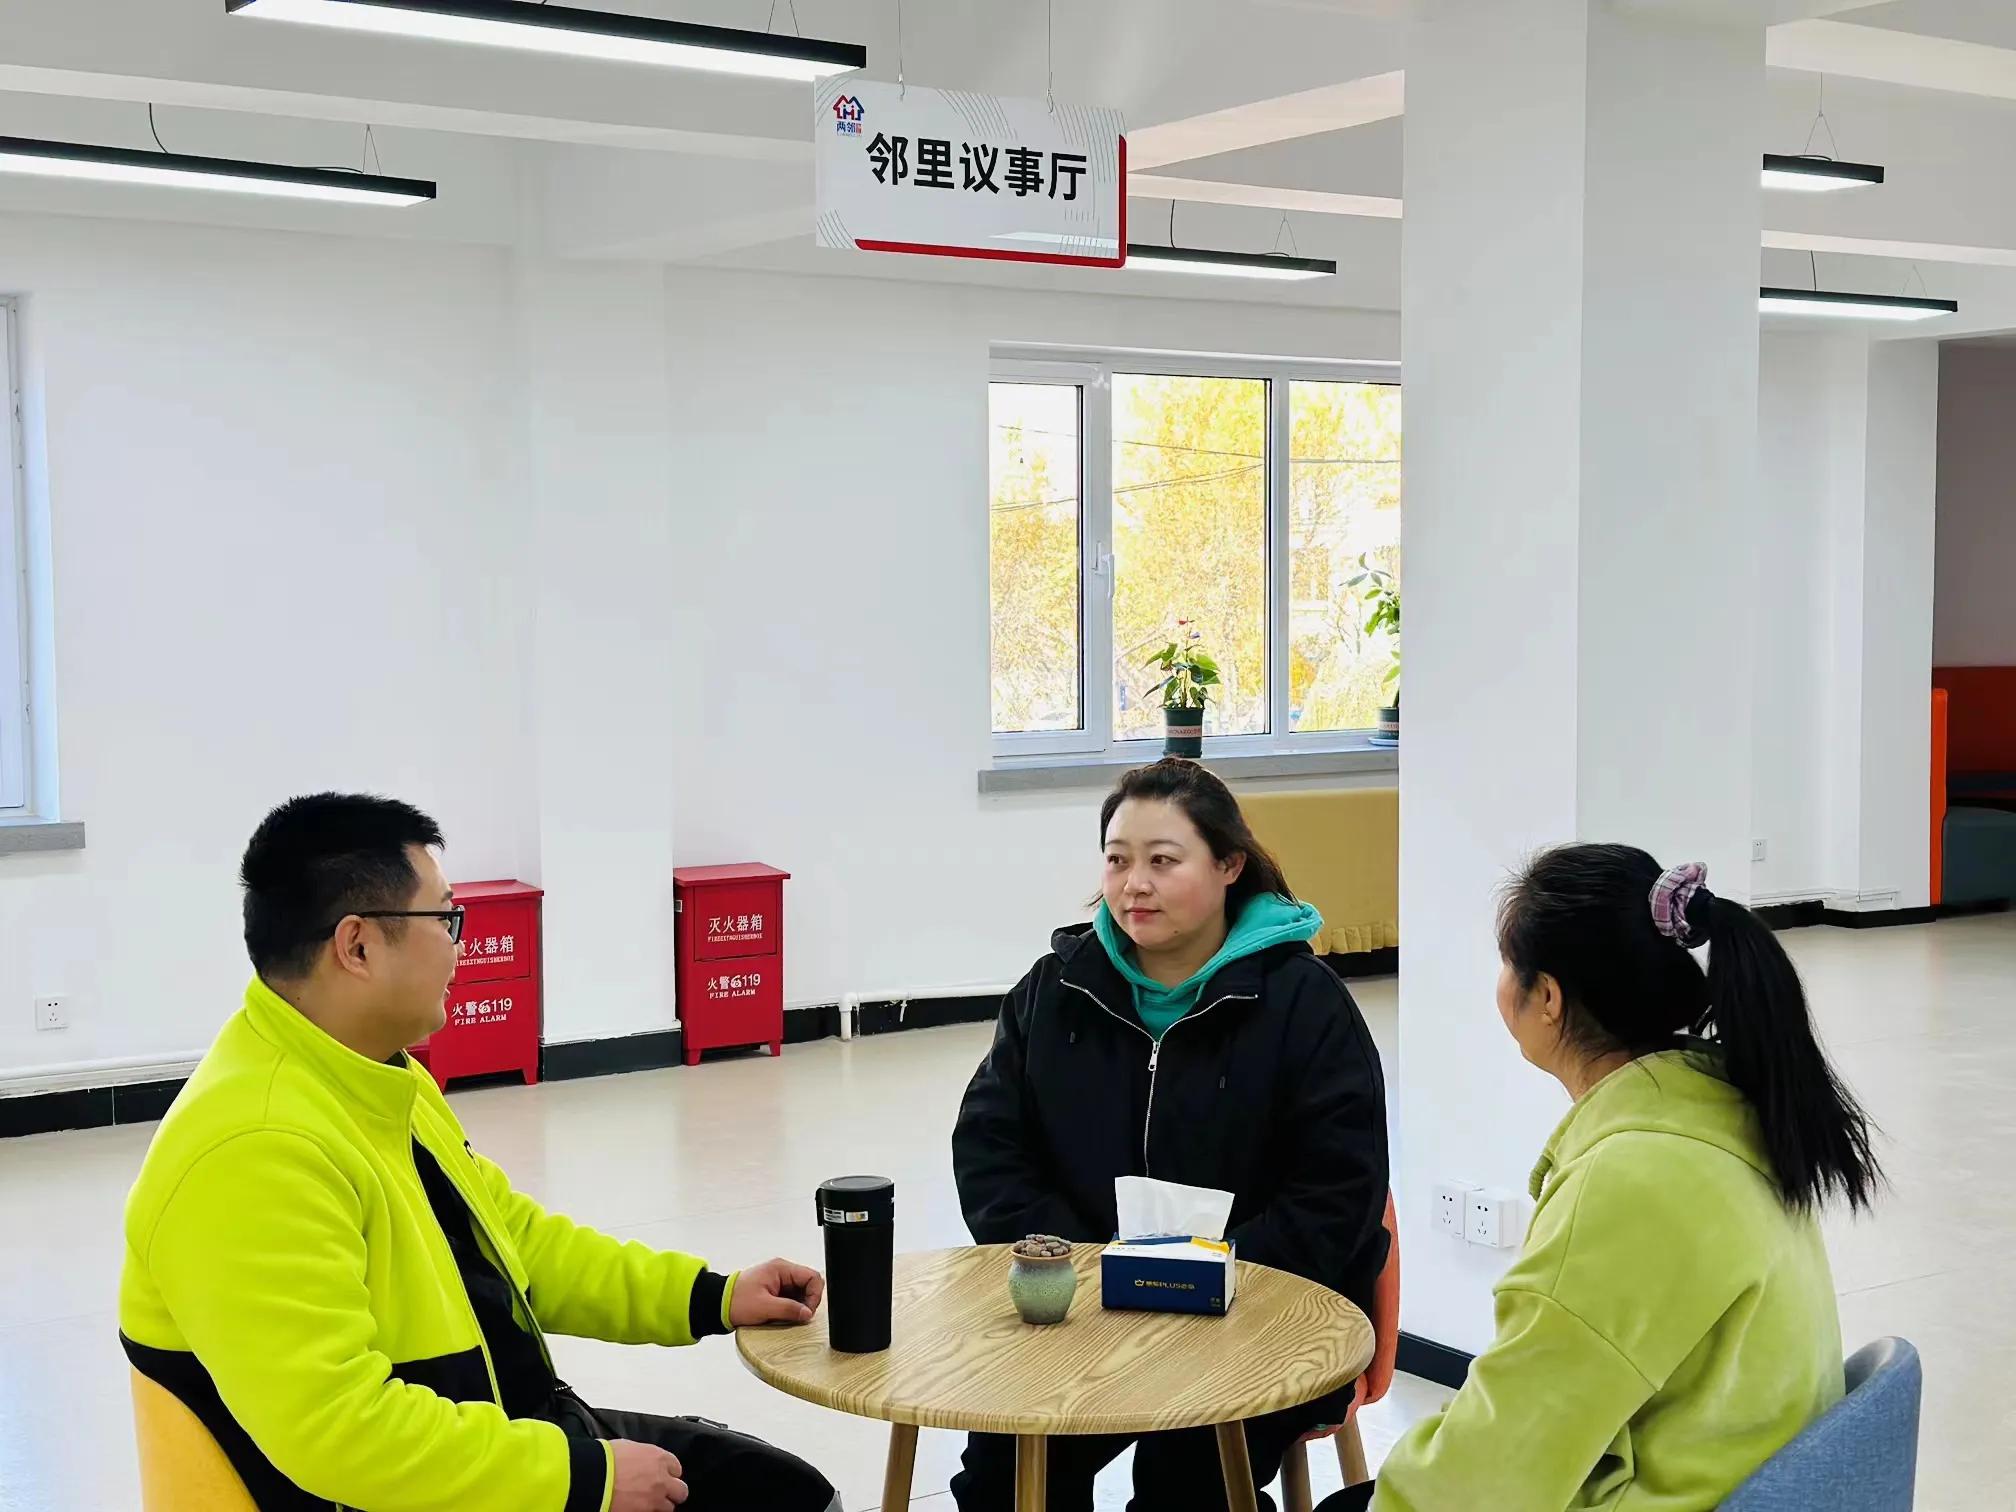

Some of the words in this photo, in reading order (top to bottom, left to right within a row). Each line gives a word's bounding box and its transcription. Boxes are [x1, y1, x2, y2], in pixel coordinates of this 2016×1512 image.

[866, 132, 1087, 201] 邻里议事厅
[708, 914, 763, 934] 灭火器箱
[709, 991, 729, 999] FIRE
[732, 988, 756, 997] ALARM
[454, 1017, 476, 1026] FIRE
[480, 1014, 507, 1023] ALARM
